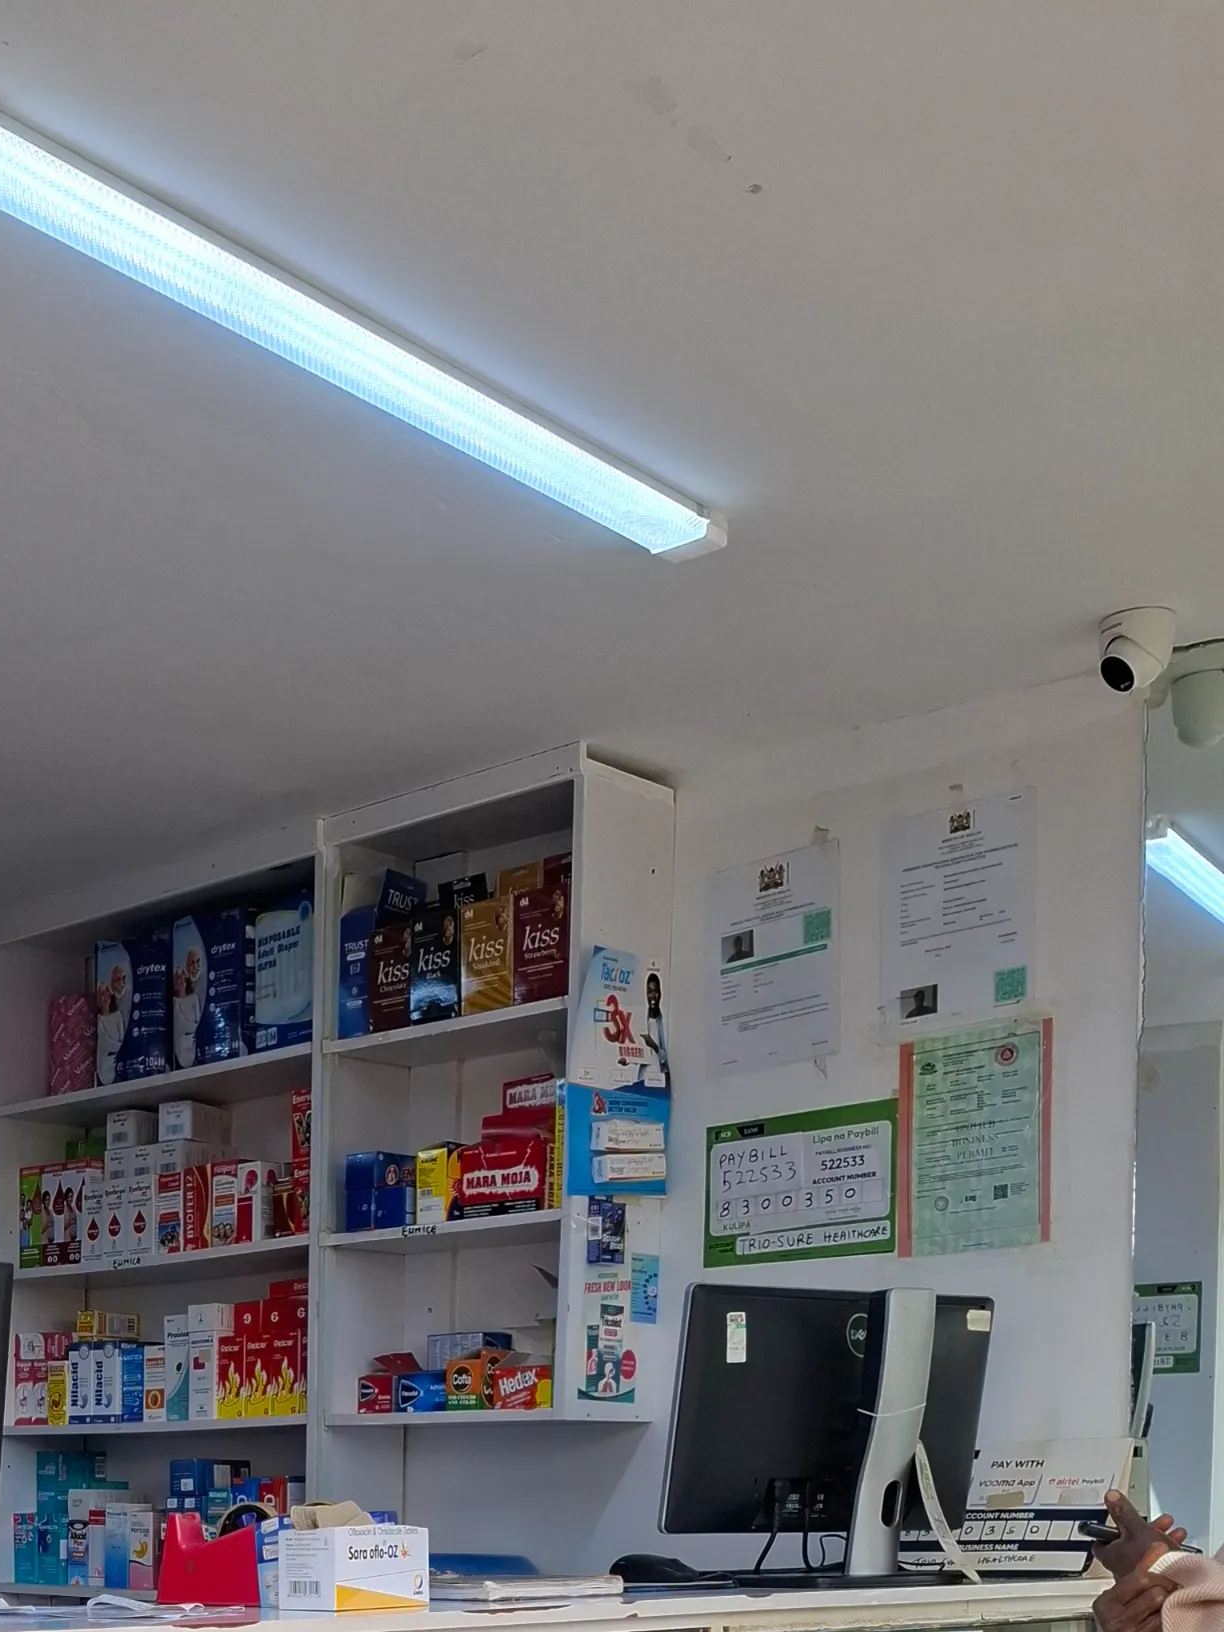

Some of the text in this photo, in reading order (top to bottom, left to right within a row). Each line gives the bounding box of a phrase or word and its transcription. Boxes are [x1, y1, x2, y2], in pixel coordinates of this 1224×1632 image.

[344, 939, 369, 950] TRUST
[522, 924, 560, 951] kiss
[468, 935, 504, 963] kiss
[417, 947, 451, 973] kiss
[137, 961, 166, 976] drytex
[377, 958, 410, 985] kiss
[813, 1127, 879, 1144] Lipa na Paybill
[821, 1155, 865, 1171] 522533
[466, 1170, 531, 1190] MARA MOJA
[812, 1171, 877, 1185] ACCOUNT NUMBER
[584, 1281, 601, 1294] FRESH
[603, 1281, 615, 1292] NEW
[70, 1362, 78, 1407] Nilacid
[452, 1373, 472, 1387] Cofta
[498, 1368, 538, 1395] Hedex
[991, 1459, 1045, 1469] PAY WITH
[348, 1546, 367, 1560] Sara
